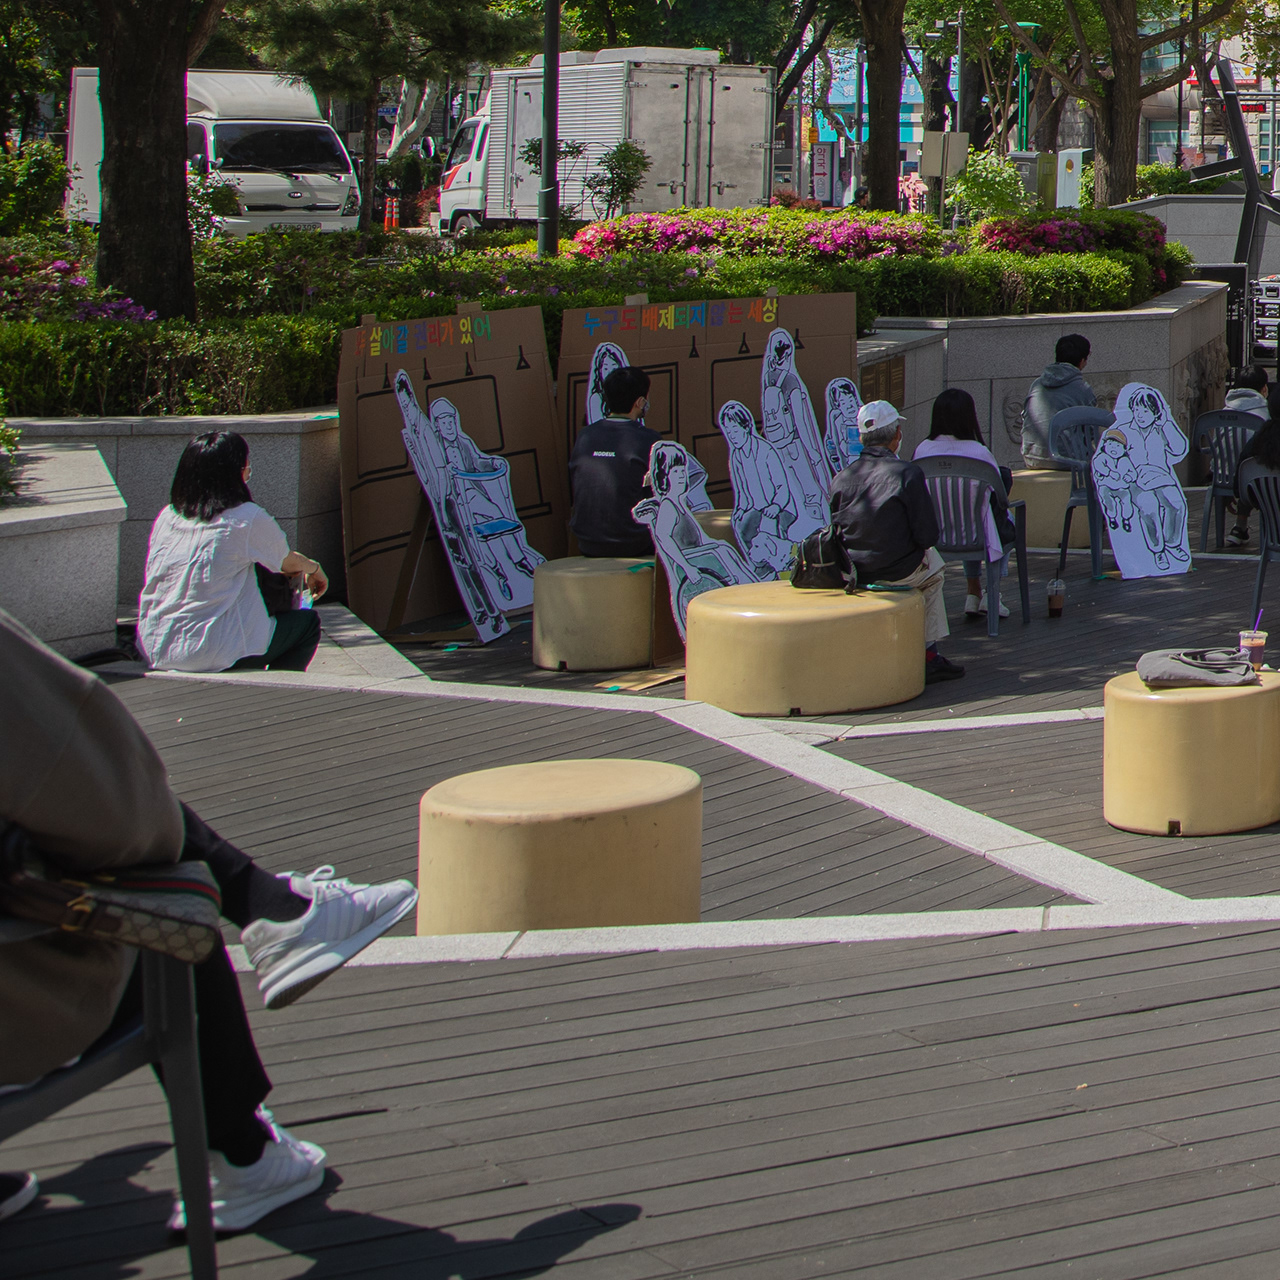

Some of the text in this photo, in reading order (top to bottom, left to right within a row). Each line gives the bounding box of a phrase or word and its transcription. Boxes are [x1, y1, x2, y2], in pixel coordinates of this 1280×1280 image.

[369, 325, 409, 357] 살아갈
[414, 319, 454, 351] 권리가
[459, 314, 492, 345] 있어
[583, 298, 779, 336] 누구도 배제되지 않는 세상
